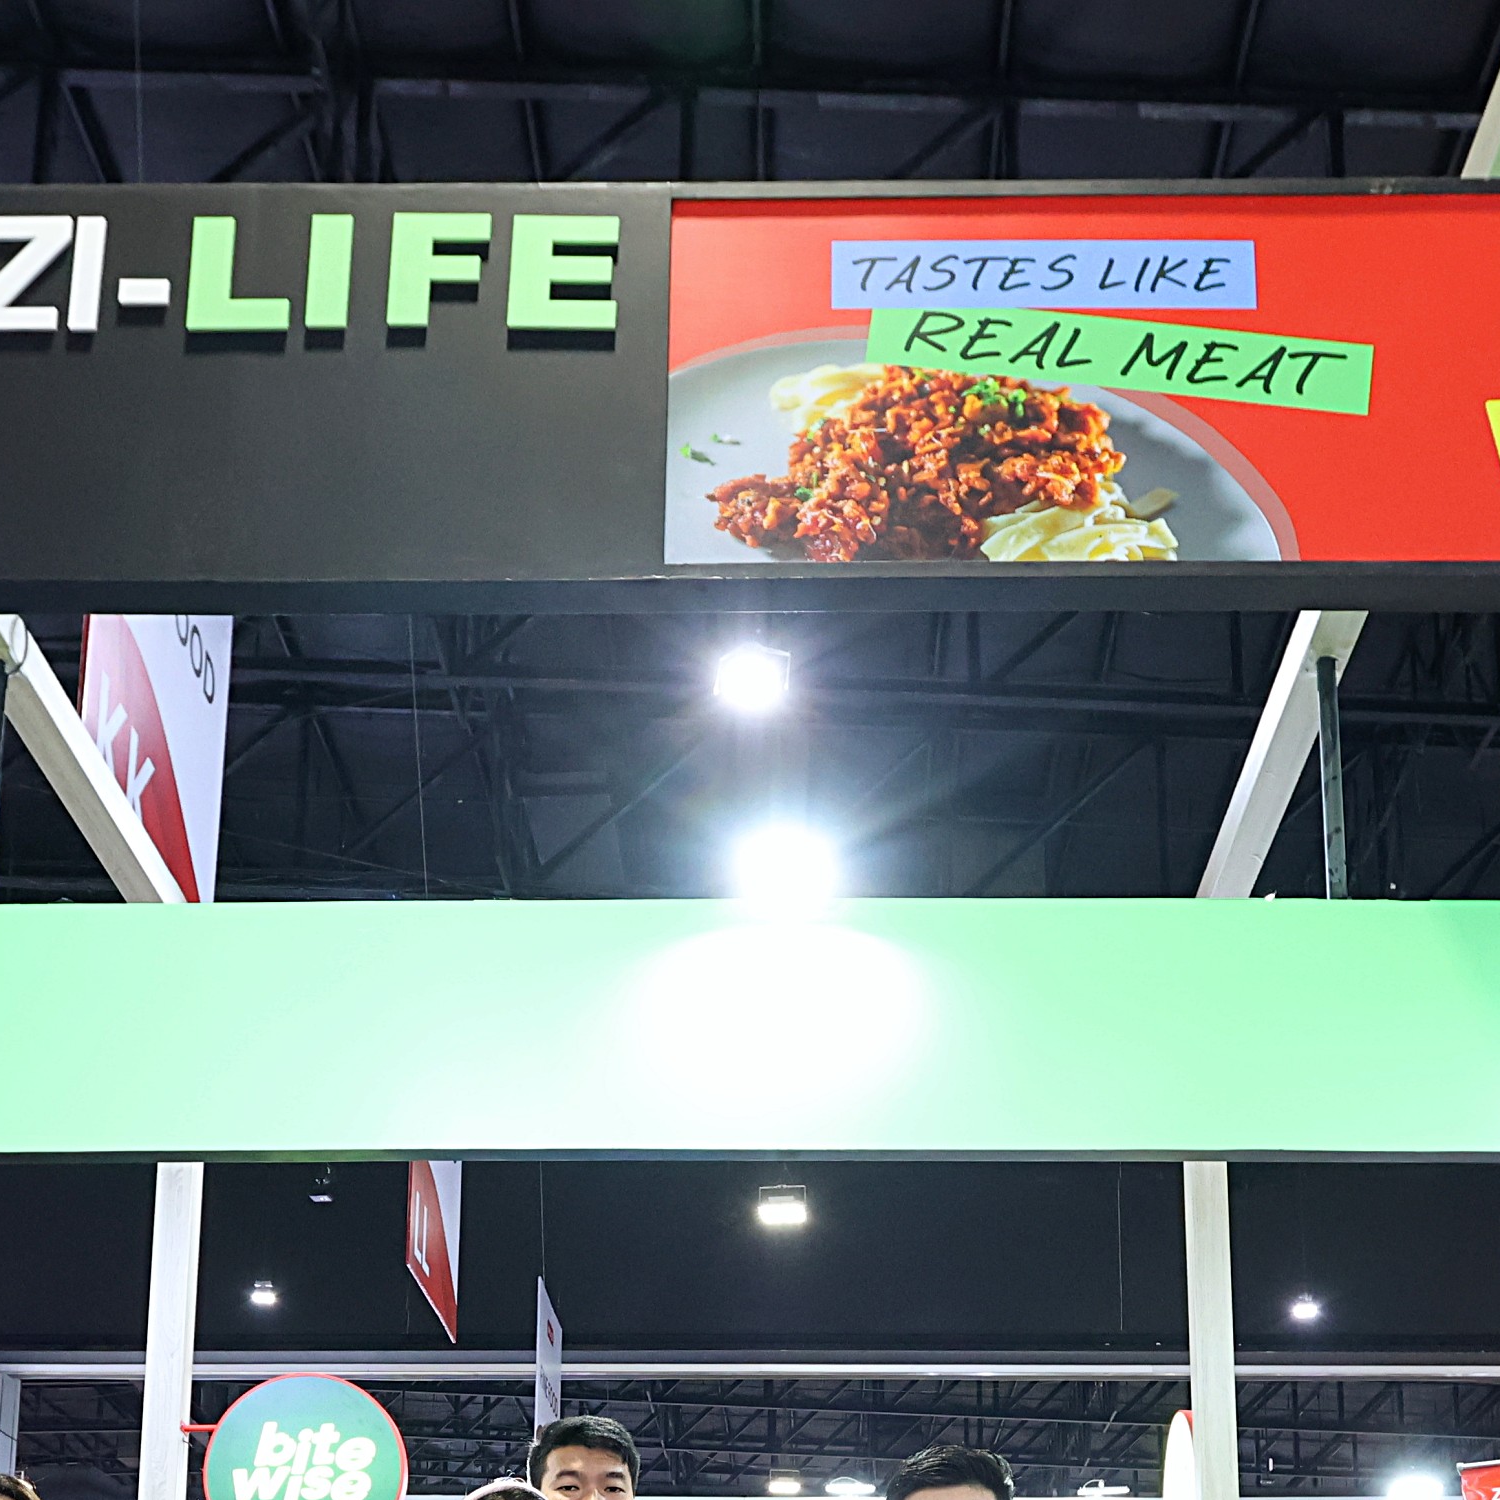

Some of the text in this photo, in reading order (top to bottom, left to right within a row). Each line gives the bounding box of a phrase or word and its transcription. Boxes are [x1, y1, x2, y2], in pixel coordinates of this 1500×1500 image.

[852, 254, 1232, 293] TASTES LIKE
[904, 310, 1348, 397] REAL MEAT
[253, 1421, 376, 1475] bite
